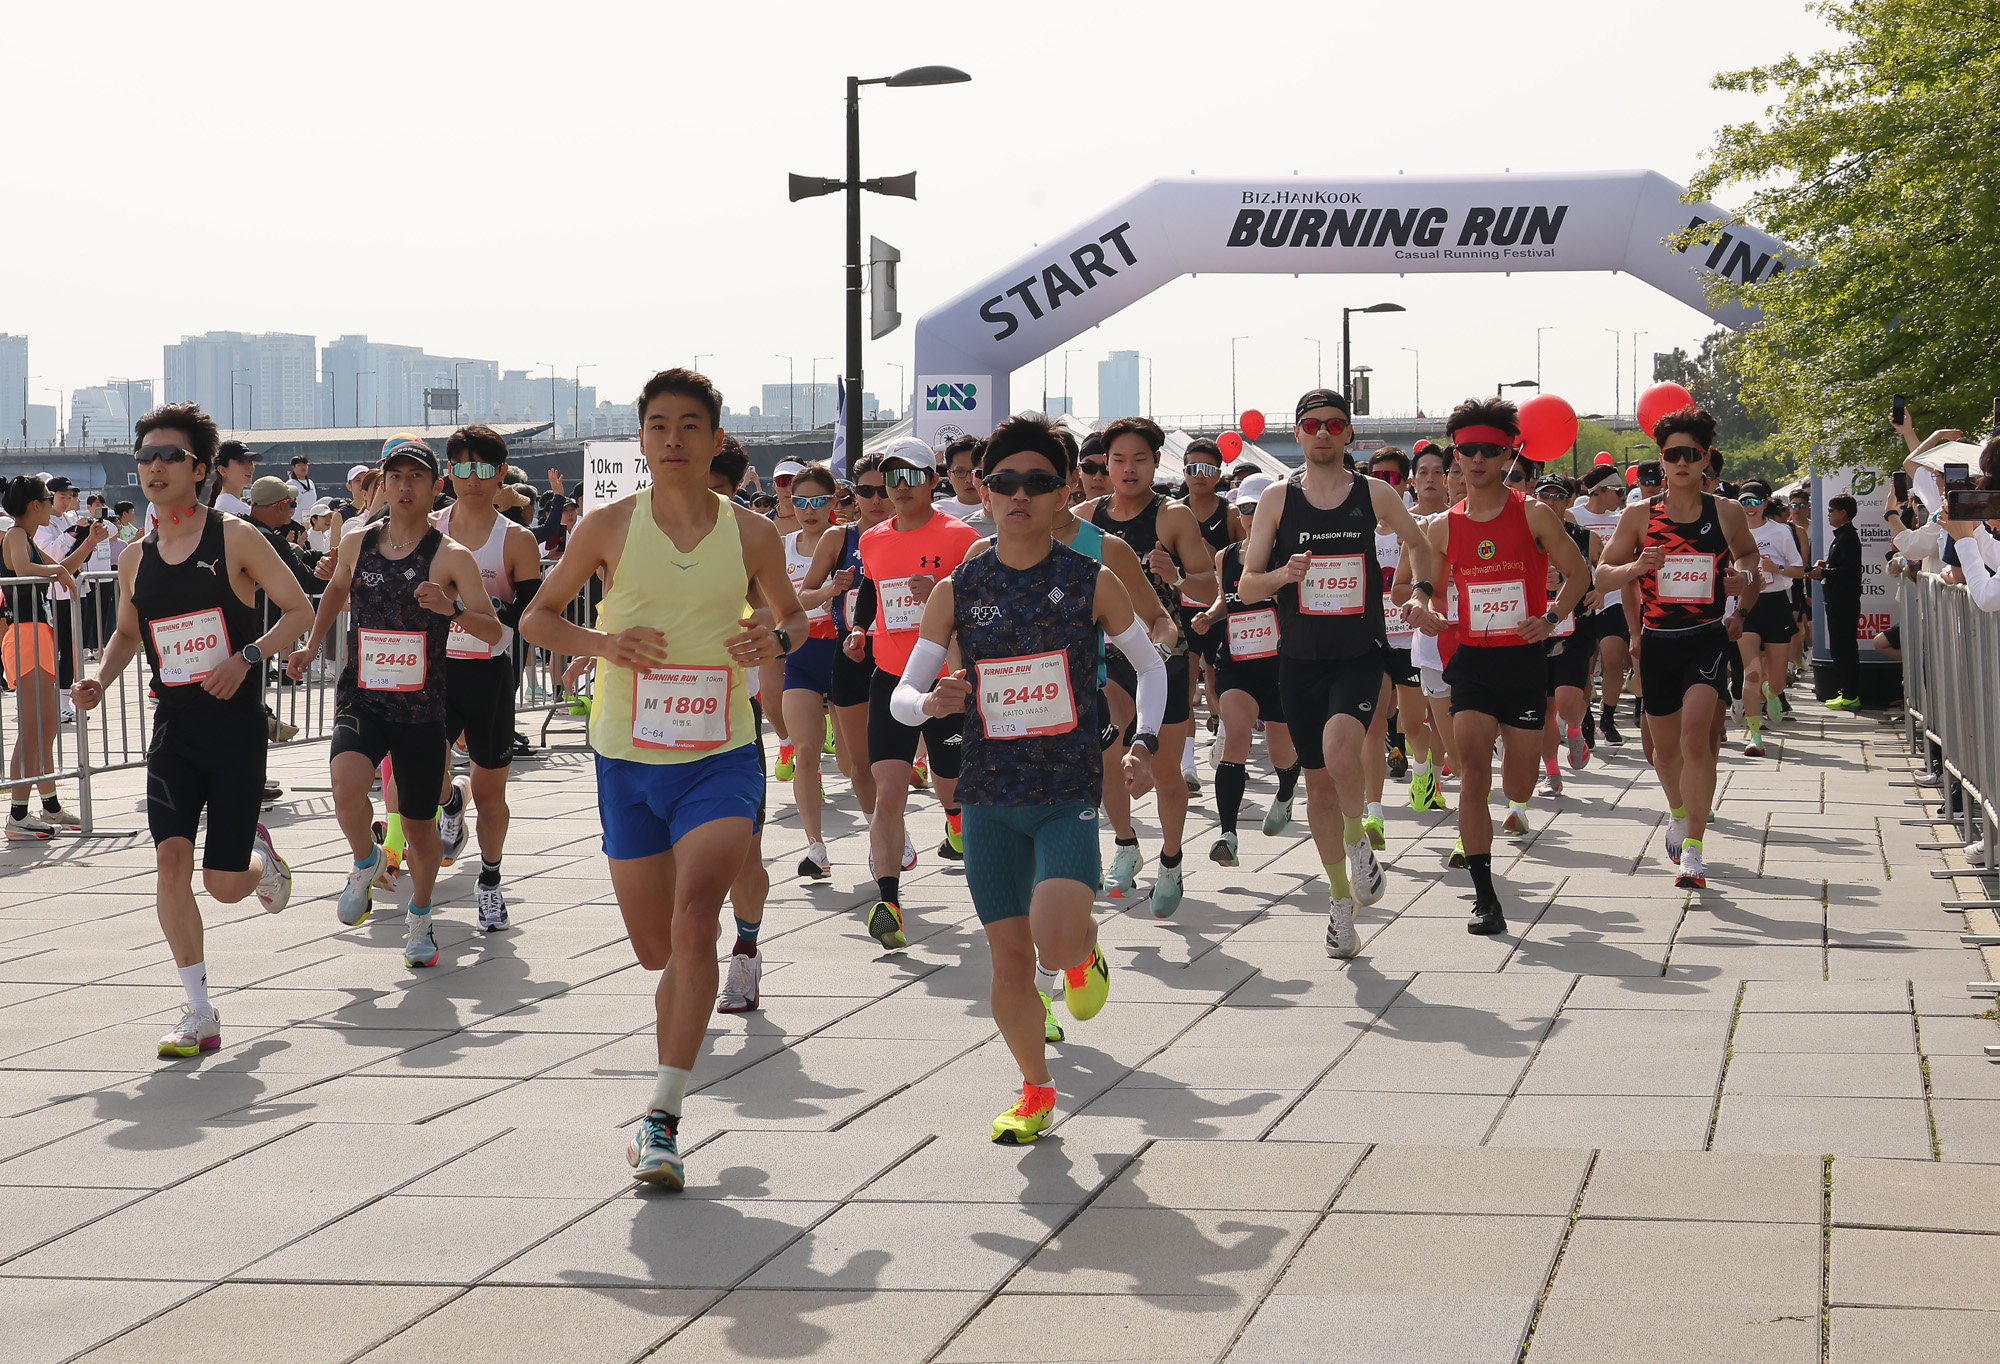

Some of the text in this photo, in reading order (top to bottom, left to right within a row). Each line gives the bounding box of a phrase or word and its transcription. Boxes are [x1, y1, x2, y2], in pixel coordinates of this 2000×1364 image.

[1226, 205, 1569, 248] BURNING RUN
[1394, 248, 1555, 260] Casual Running Festival
[979, 221, 1138, 342] START
[938, 426, 962, 436] SUNBODY
[590, 458, 649, 474] 10km 7k
[594, 480, 618, 498] 선수
[1312, 532, 1341, 540] PASSION
[1672, 571, 1707, 582] 2464
[1318, 577, 1357, 589] 1955
[1384, 608, 1402, 617] 20
[1482, 600, 1519, 614] 2457
[157, 623, 180, 632] BURNING
[181, 620, 194, 629] RUN
[1240, 626, 1272, 639] 3734
[162, 634, 217, 655] M 1460
[375, 653, 417, 666] 2448
[984, 666, 1014, 676] BURNING
[1015, 664, 1032, 673] RUN
[1040, 661, 1060, 669] 10km
[643, 673, 679, 681] BURNING
[986, 683, 1058, 706] M 2449
[644, 697, 717, 714] M 1809
[1002, 706, 1048, 718] KAITO IWASA
[642, 727, 664, 738] C-64
[992, 724, 1016, 732] E-173
